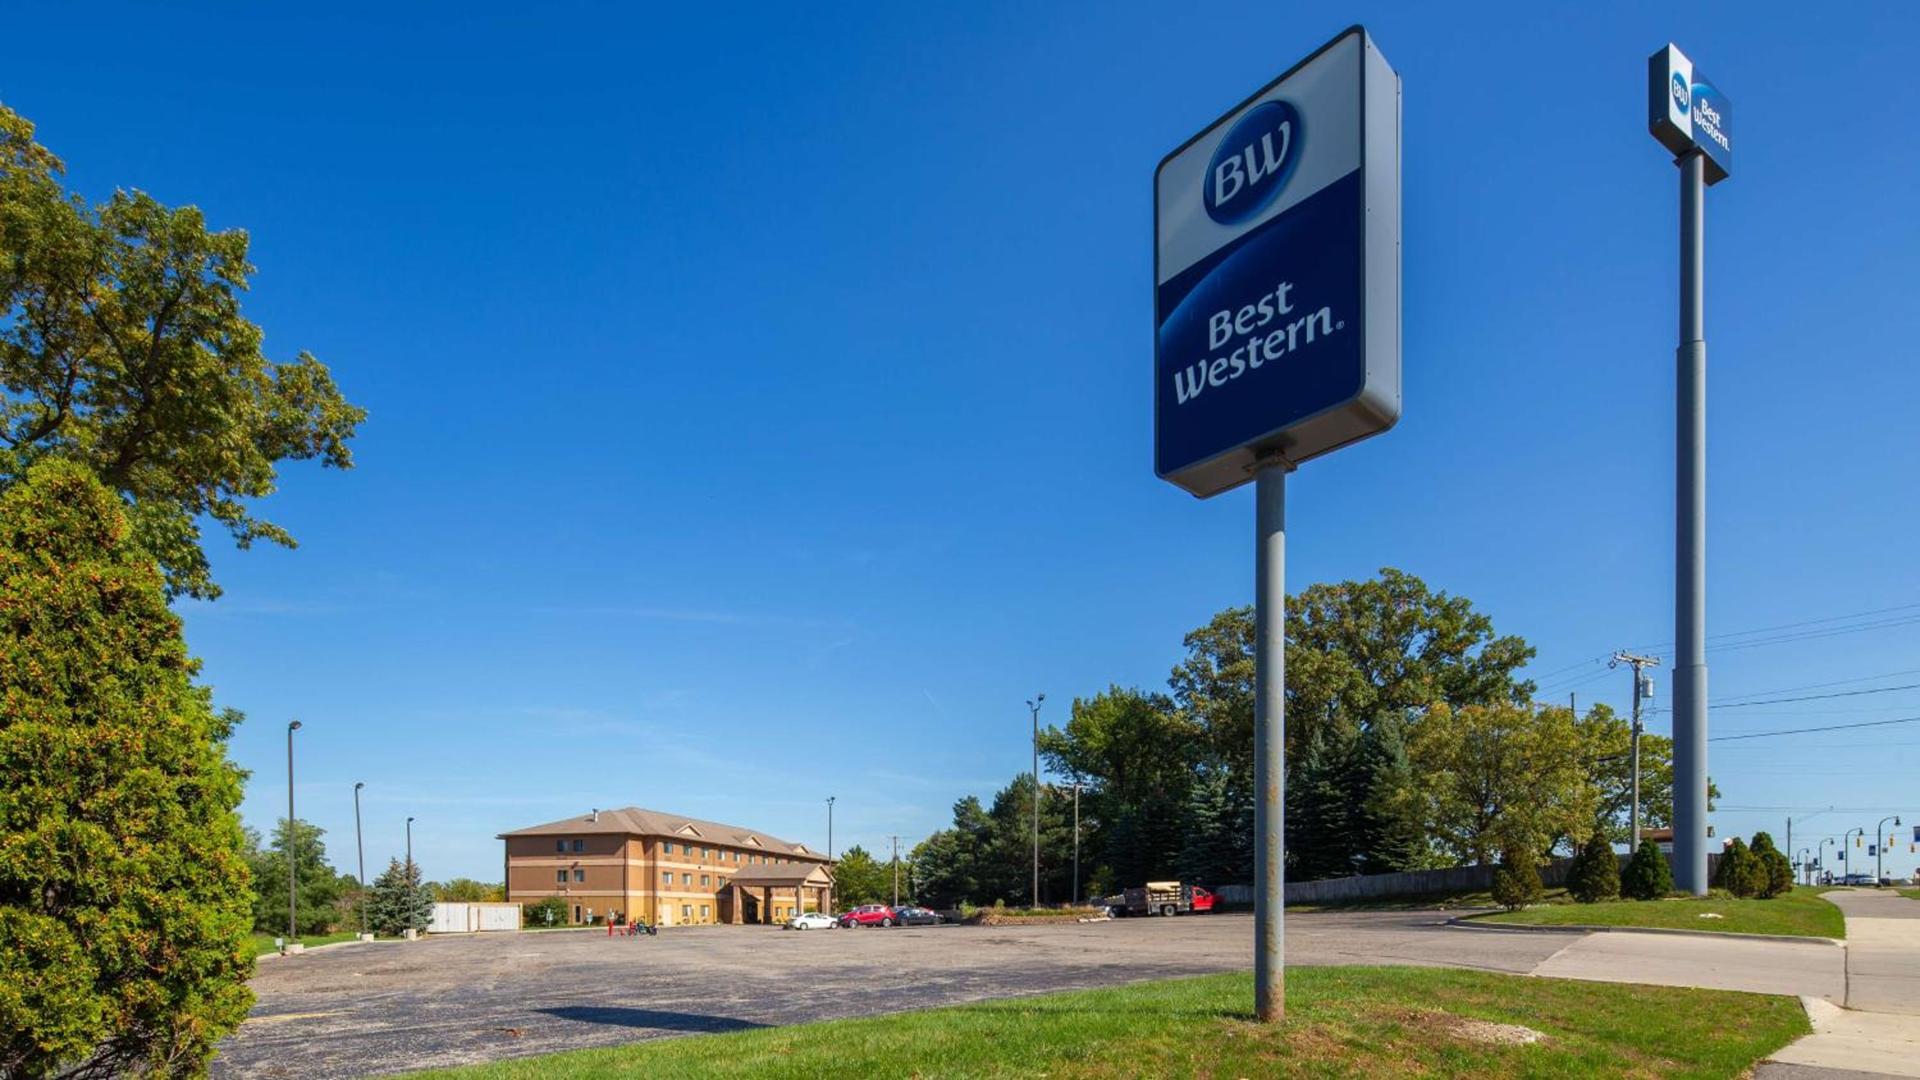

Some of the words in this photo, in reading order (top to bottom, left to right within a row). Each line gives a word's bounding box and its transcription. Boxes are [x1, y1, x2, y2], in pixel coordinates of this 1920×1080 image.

[1673, 79, 1688, 106] BW
[1701, 98, 1720, 128] Best
[1215, 121, 1291, 207] BW
[1208, 281, 1295, 351] Best
